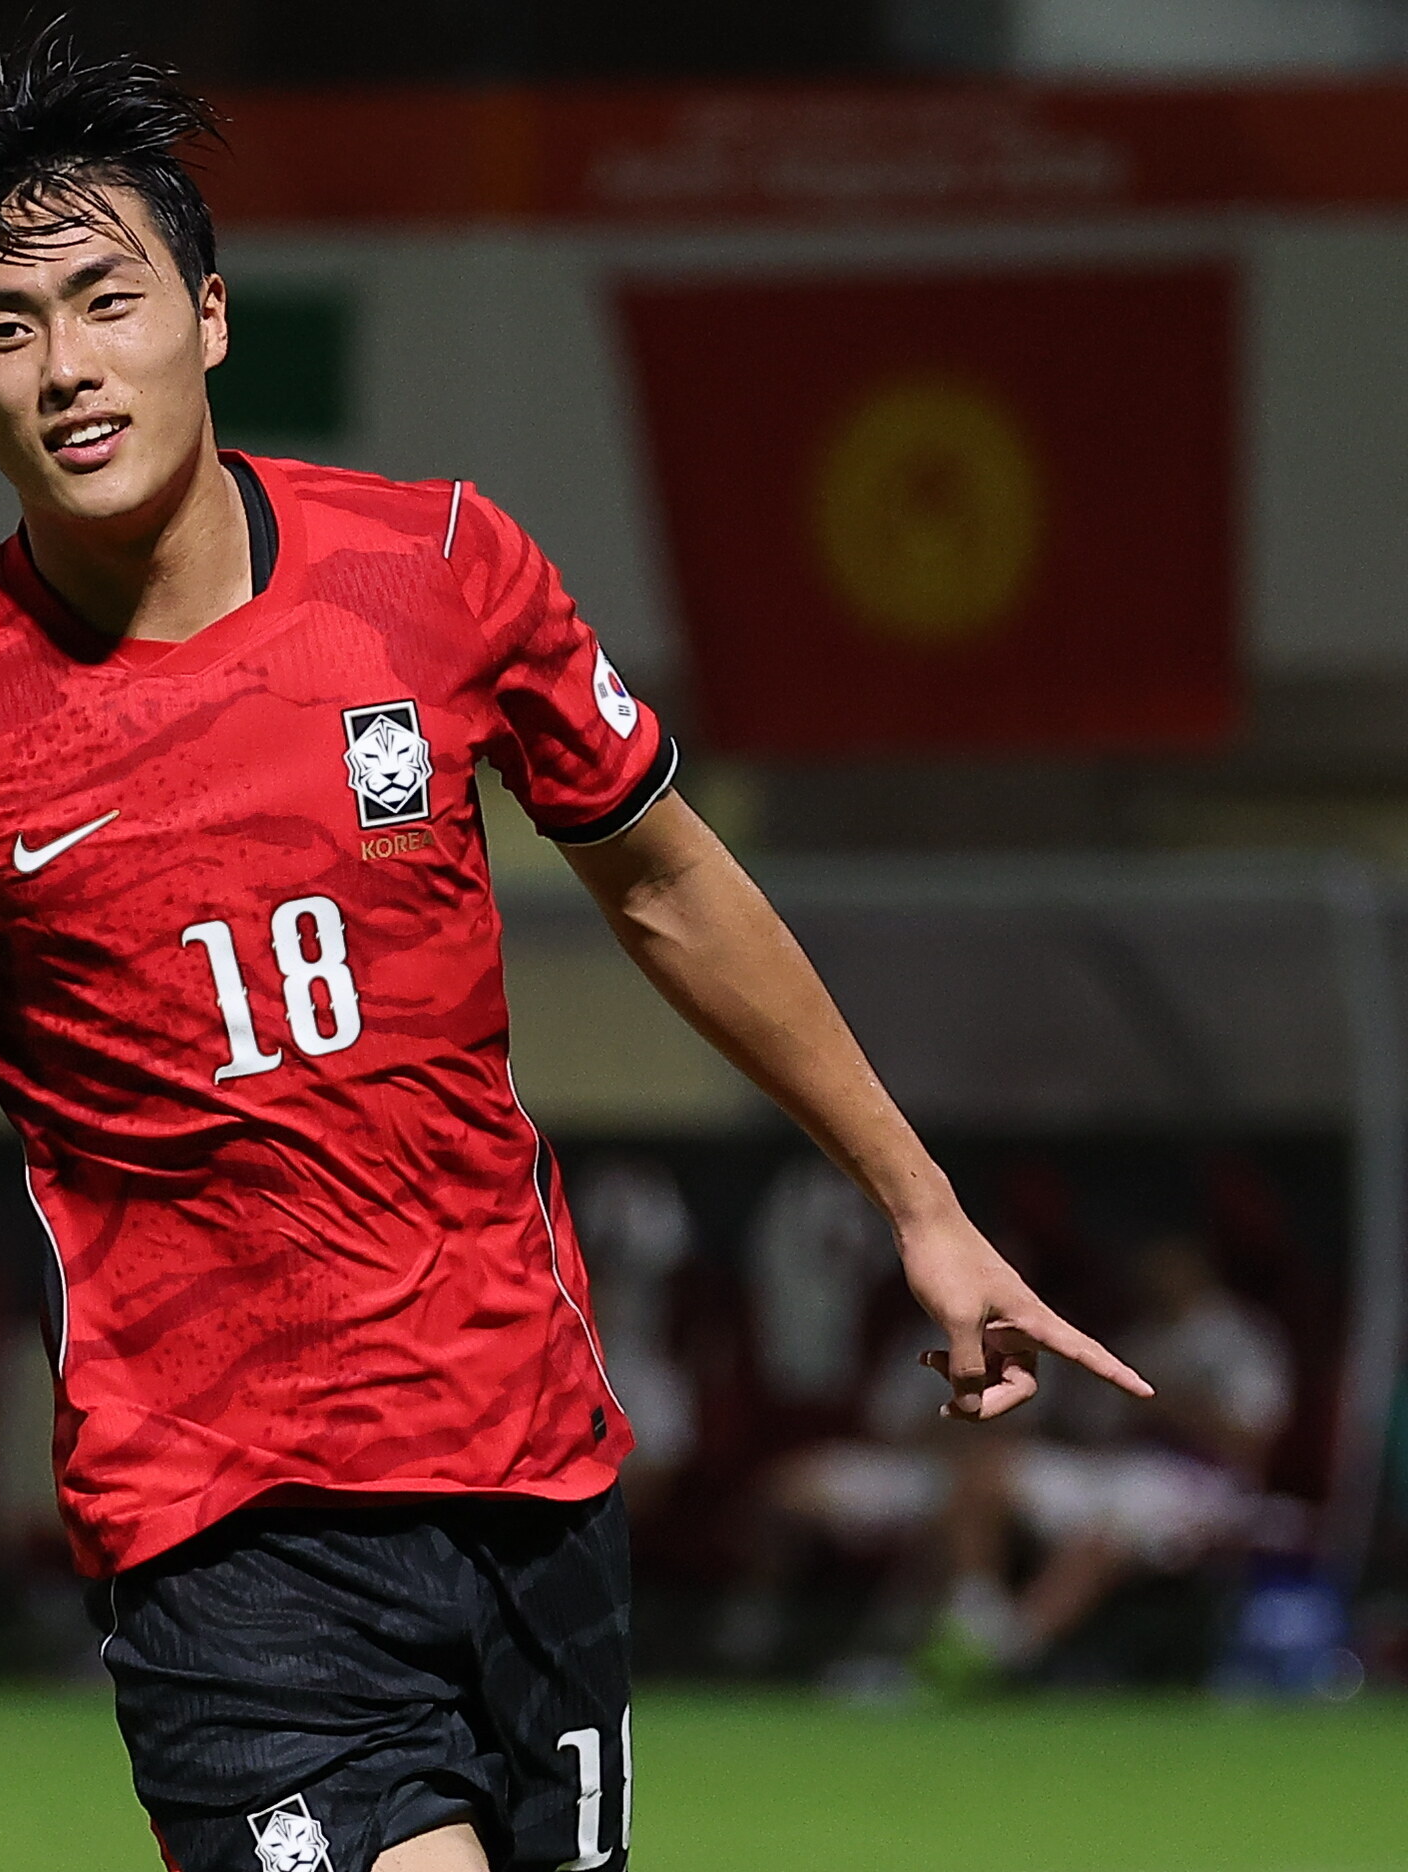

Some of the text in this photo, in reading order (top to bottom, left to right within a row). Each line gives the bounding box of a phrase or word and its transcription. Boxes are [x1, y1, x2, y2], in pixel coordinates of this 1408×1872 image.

[360, 830, 435, 861] KOREA
[181, 895, 362, 1086] 18
[555, 1702, 632, 1872] 1
